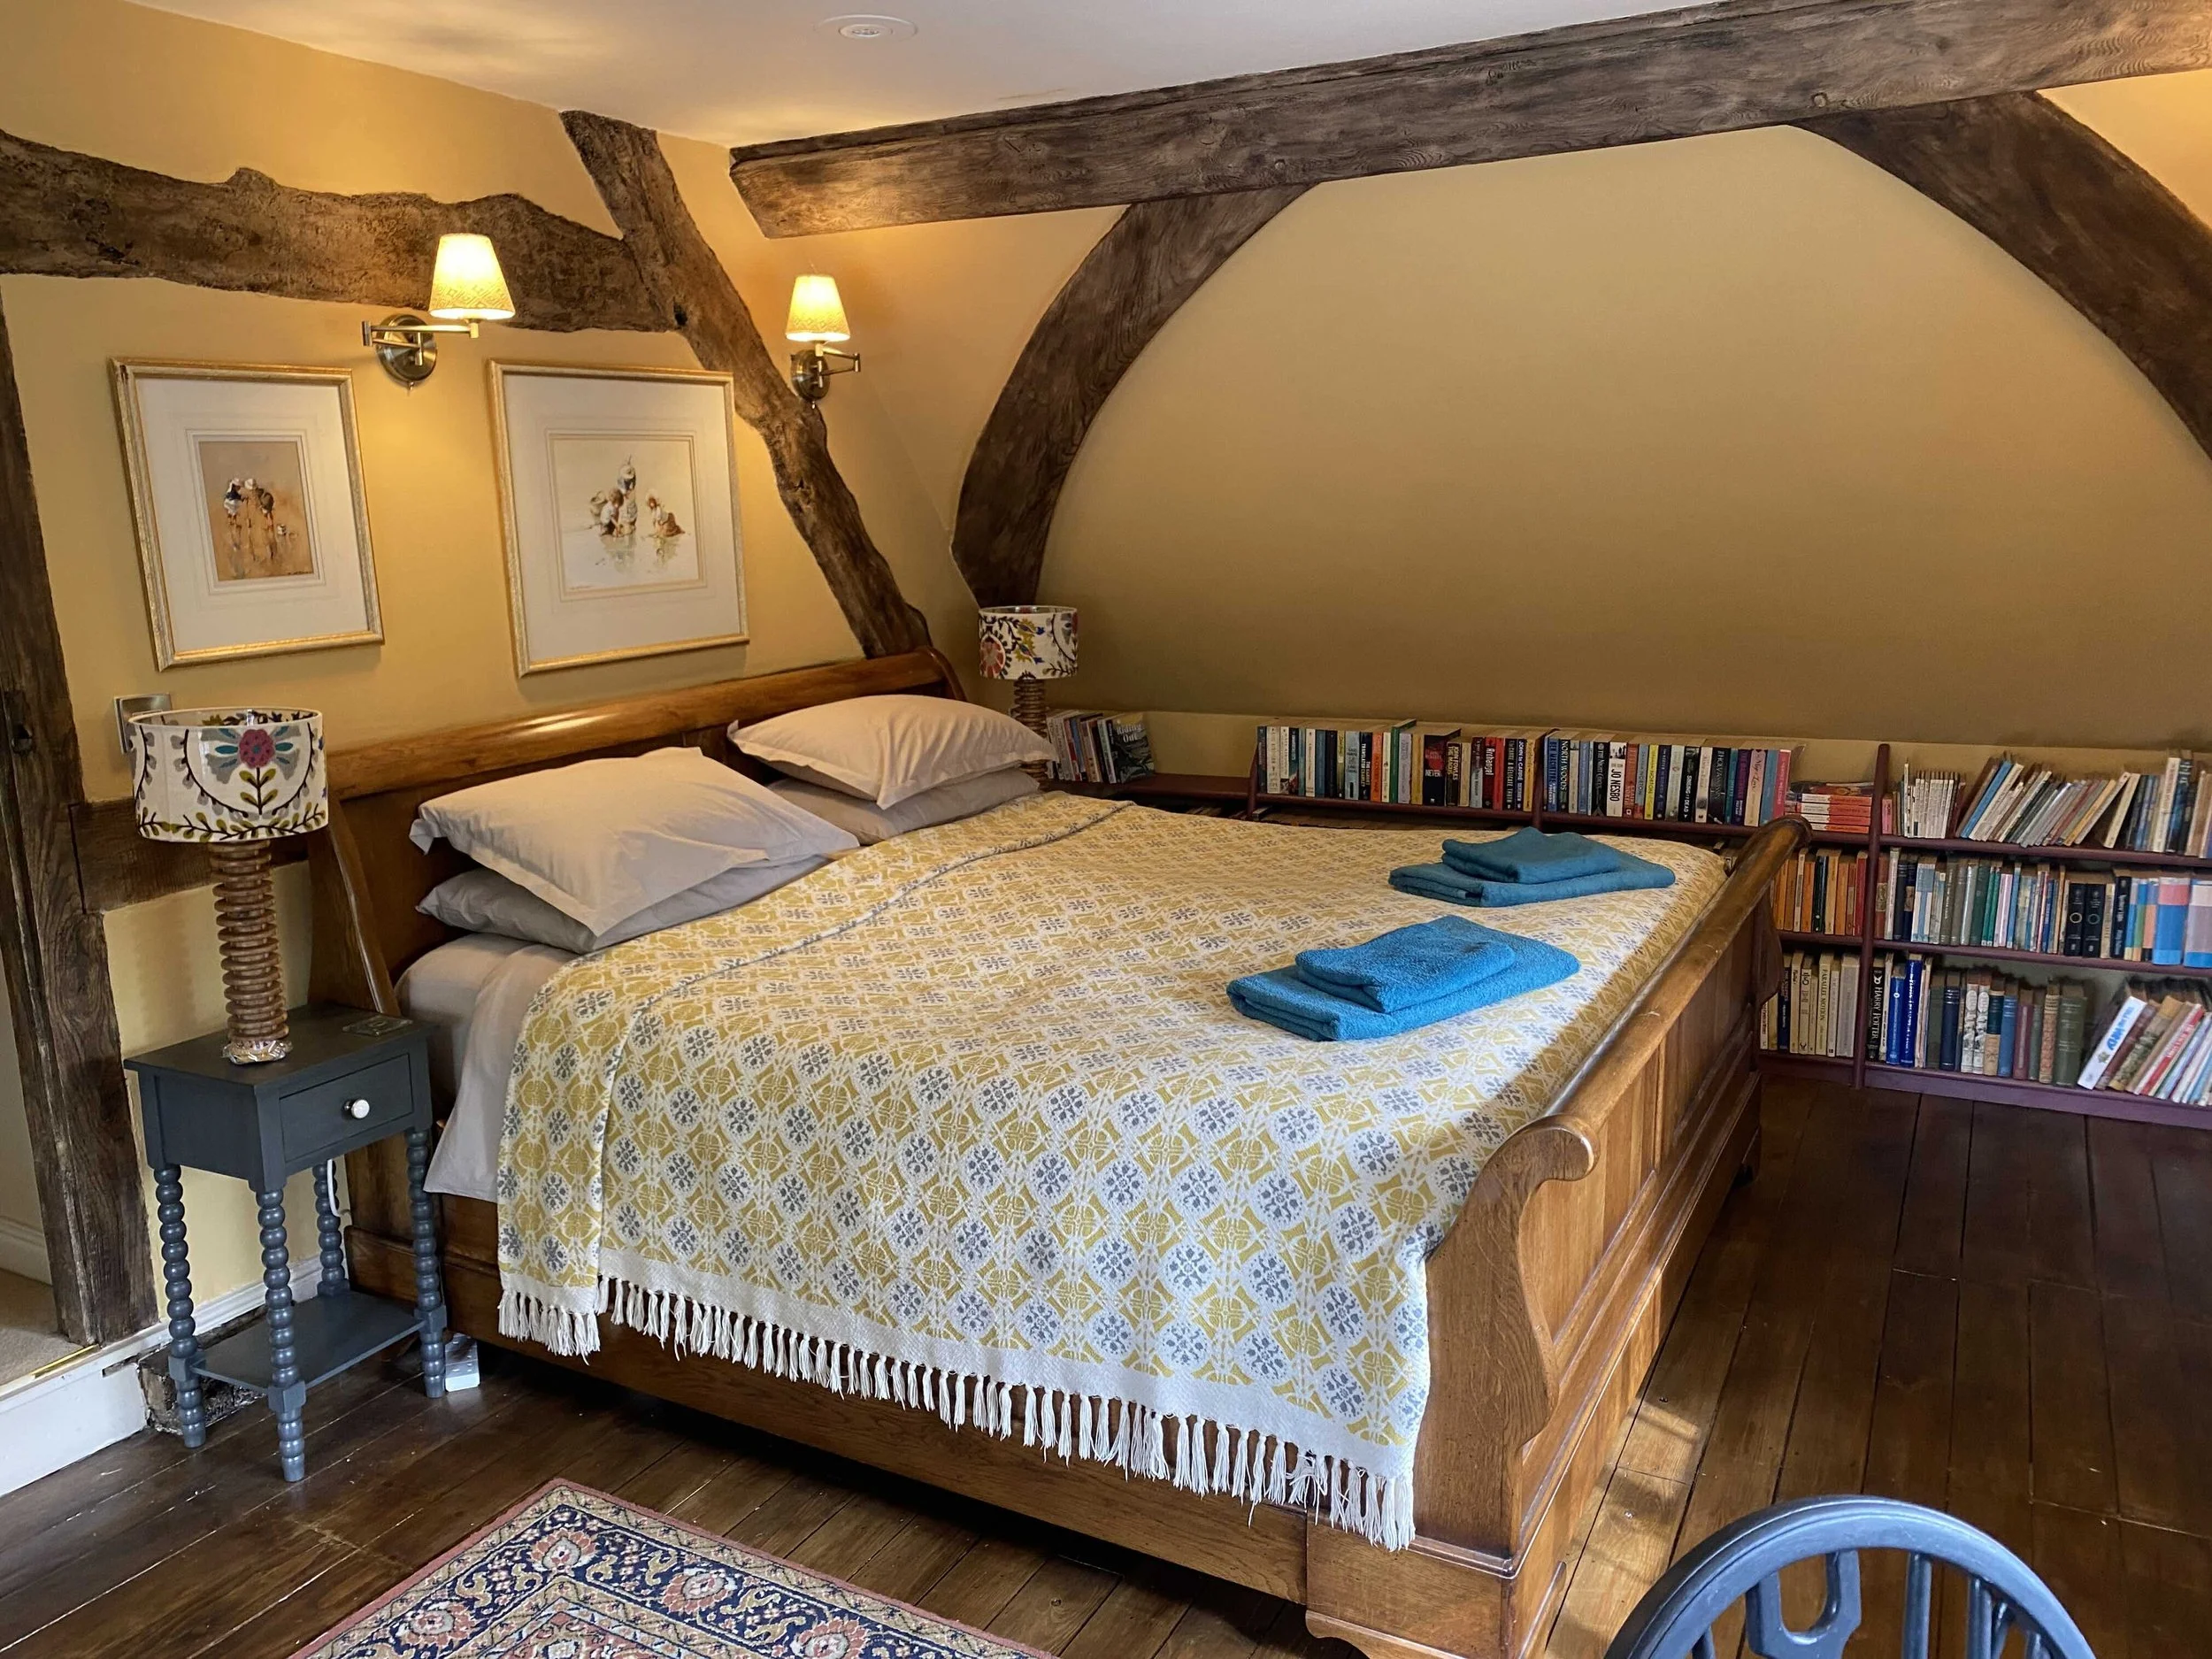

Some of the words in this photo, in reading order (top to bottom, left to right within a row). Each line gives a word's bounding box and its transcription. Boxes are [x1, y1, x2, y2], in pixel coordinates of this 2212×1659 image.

[1117, 723, 1143, 735] Riding
[1123, 733, 1138, 743] Out
[1484, 748, 1494, 775] Archangel
[1610, 769, 1621, 778] JO
[1872, 986, 1882, 1010] HARRY
[1870, 1012, 1880, 1039] POTTER
